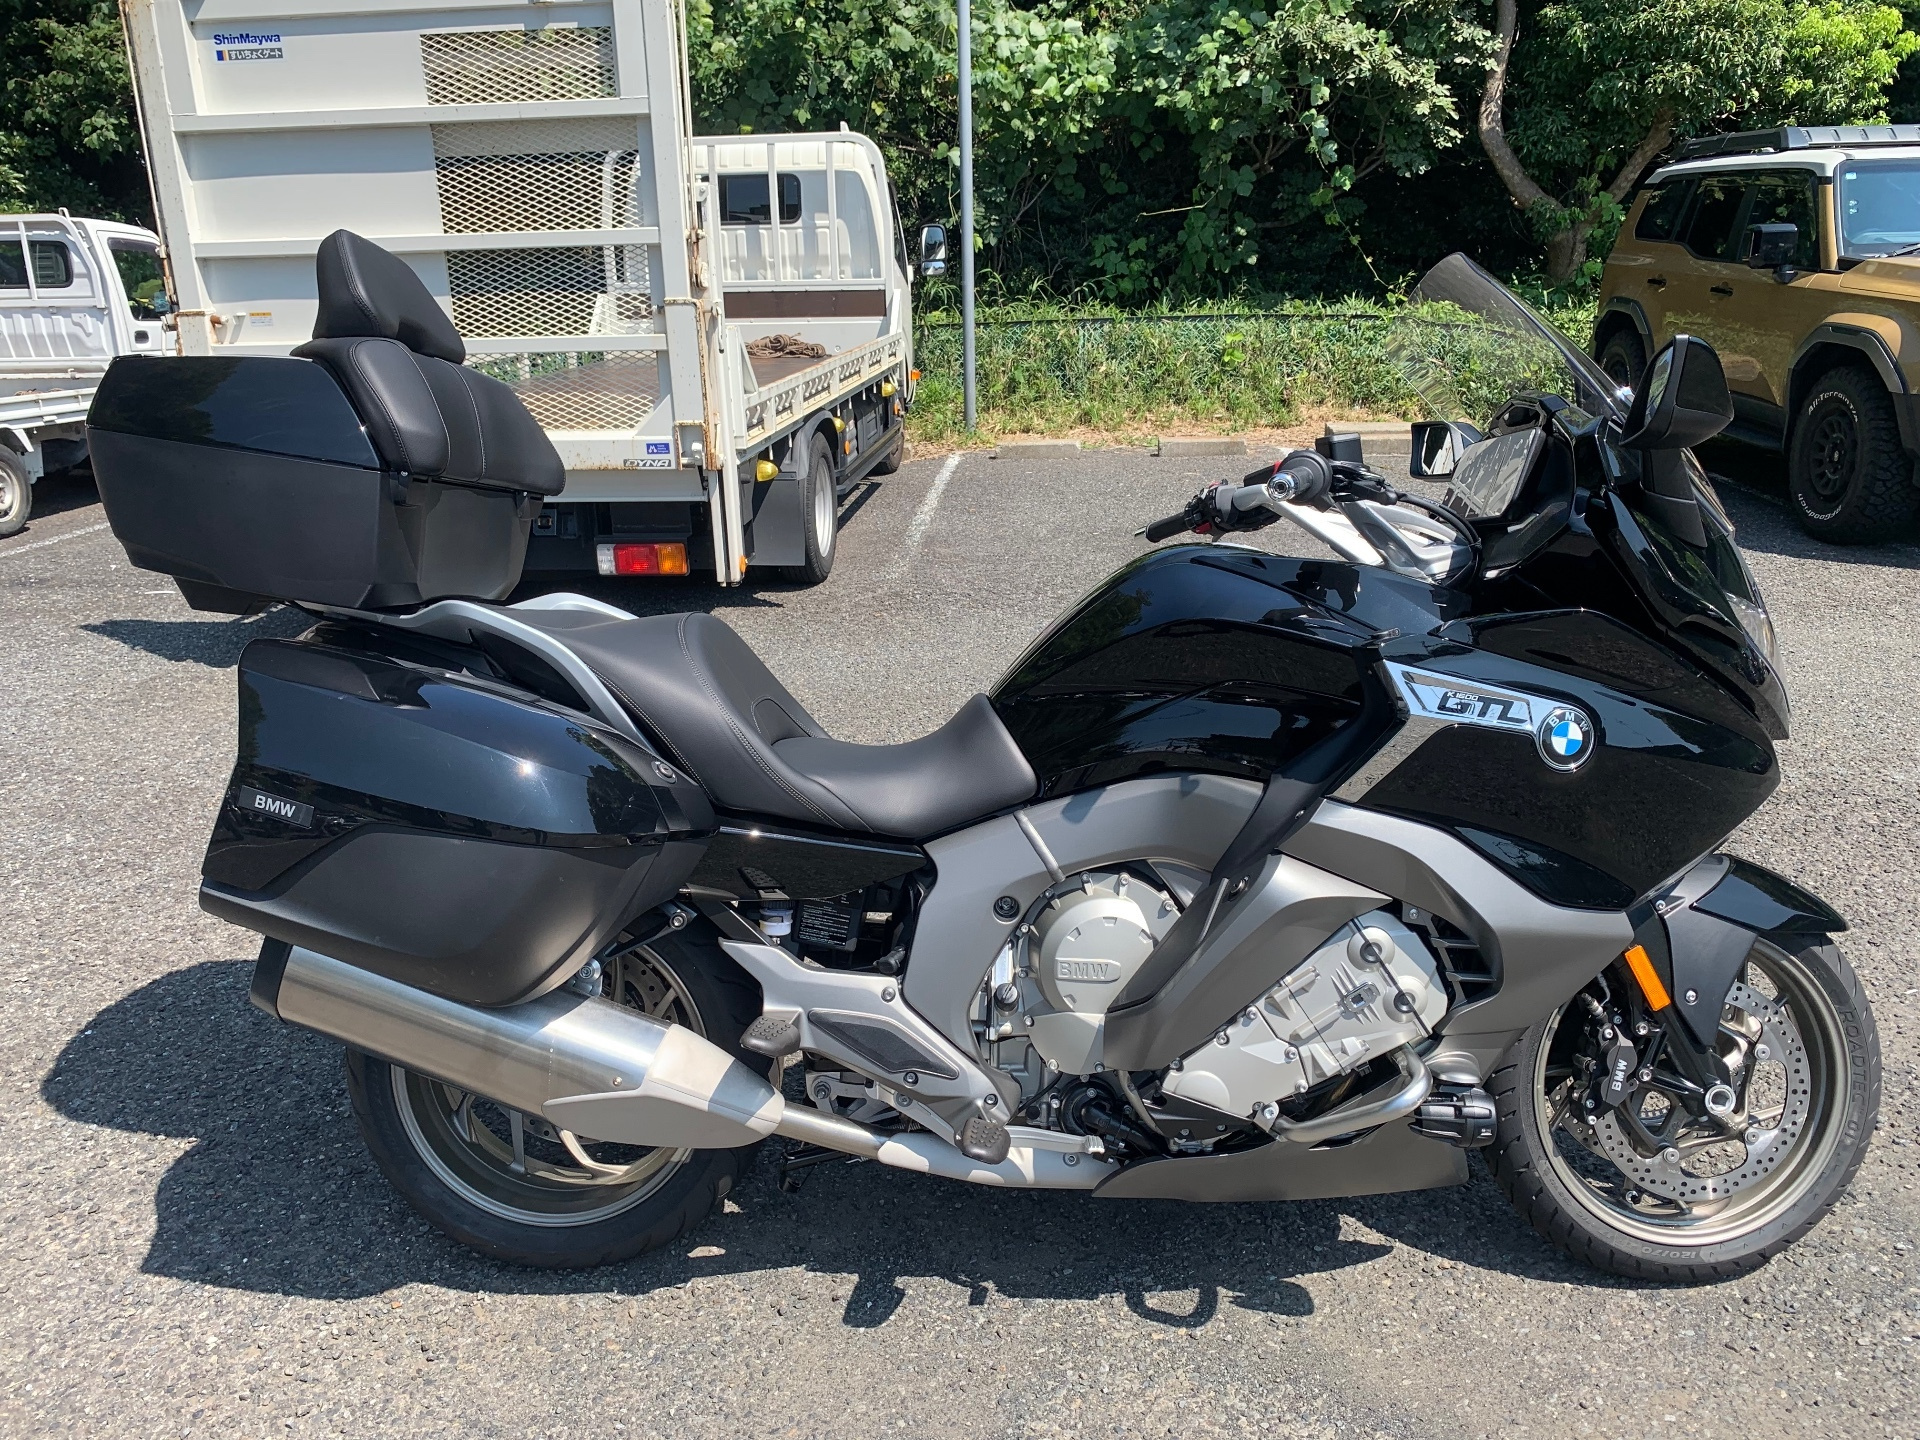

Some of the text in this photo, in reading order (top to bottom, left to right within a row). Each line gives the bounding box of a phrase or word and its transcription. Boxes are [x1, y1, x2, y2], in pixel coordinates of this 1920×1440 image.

[213, 33, 281, 45] ShinMaywa
[229, 48, 282, 60] すいちょくゲート
[625, 459, 670, 468] DYNA
[1456, 693, 1479, 701] 1600
[1437, 691, 1528, 724] GTL
[1549, 712, 1589, 732] BMW
[254, 794, 296, 818] BMW
[1058, 961, 1108, 979] BMW
[1611, 1058, 1628, 1091] BMW
[1641, 1246, 1697, 1259] 120/70
